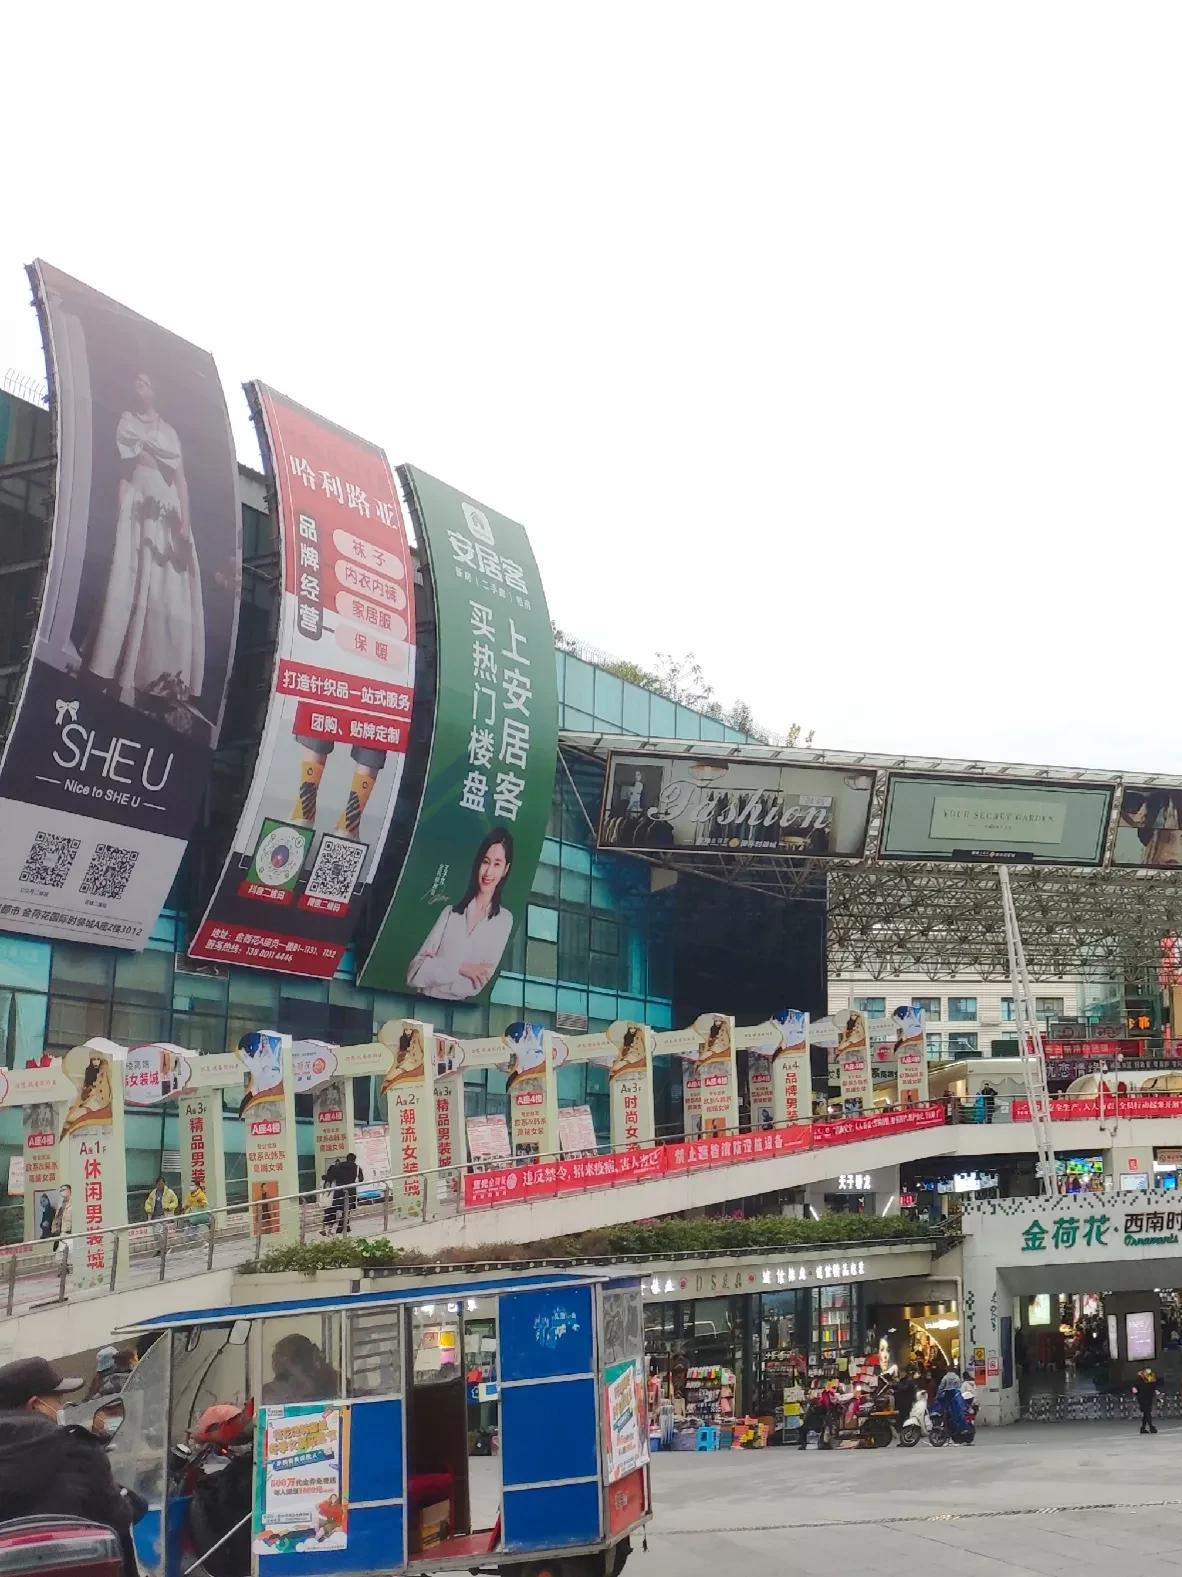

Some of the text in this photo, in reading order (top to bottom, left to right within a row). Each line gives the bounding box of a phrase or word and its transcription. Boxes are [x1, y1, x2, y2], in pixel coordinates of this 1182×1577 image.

[290, 455, 398, 529] 哈利路亚
[299, 514, 320, 633] 品牌经营
[344, 565, 398, 602] 内衣内裤
[447, 529, 529, 594] 安居客
[352, 600, 392, 631] 家居服
[282, 669, 411, 711] 打造针织品一站式服务
[459, 599, 497, 813] 买热门楼盘
[310, 713, 401, 745] 团购、贴牌定制
[494, 618, 533, 821] 上安居客
[64, 778, 90, 795] Nice
[91, 786, 103, 798] to
[647, 780, 831, 830] Fashion
[0, 903, 20, 915] 都市
[401, 1108, 421, 1197] 潮流女装城
[85, 1158, 104, 1269] 休闲男装城
